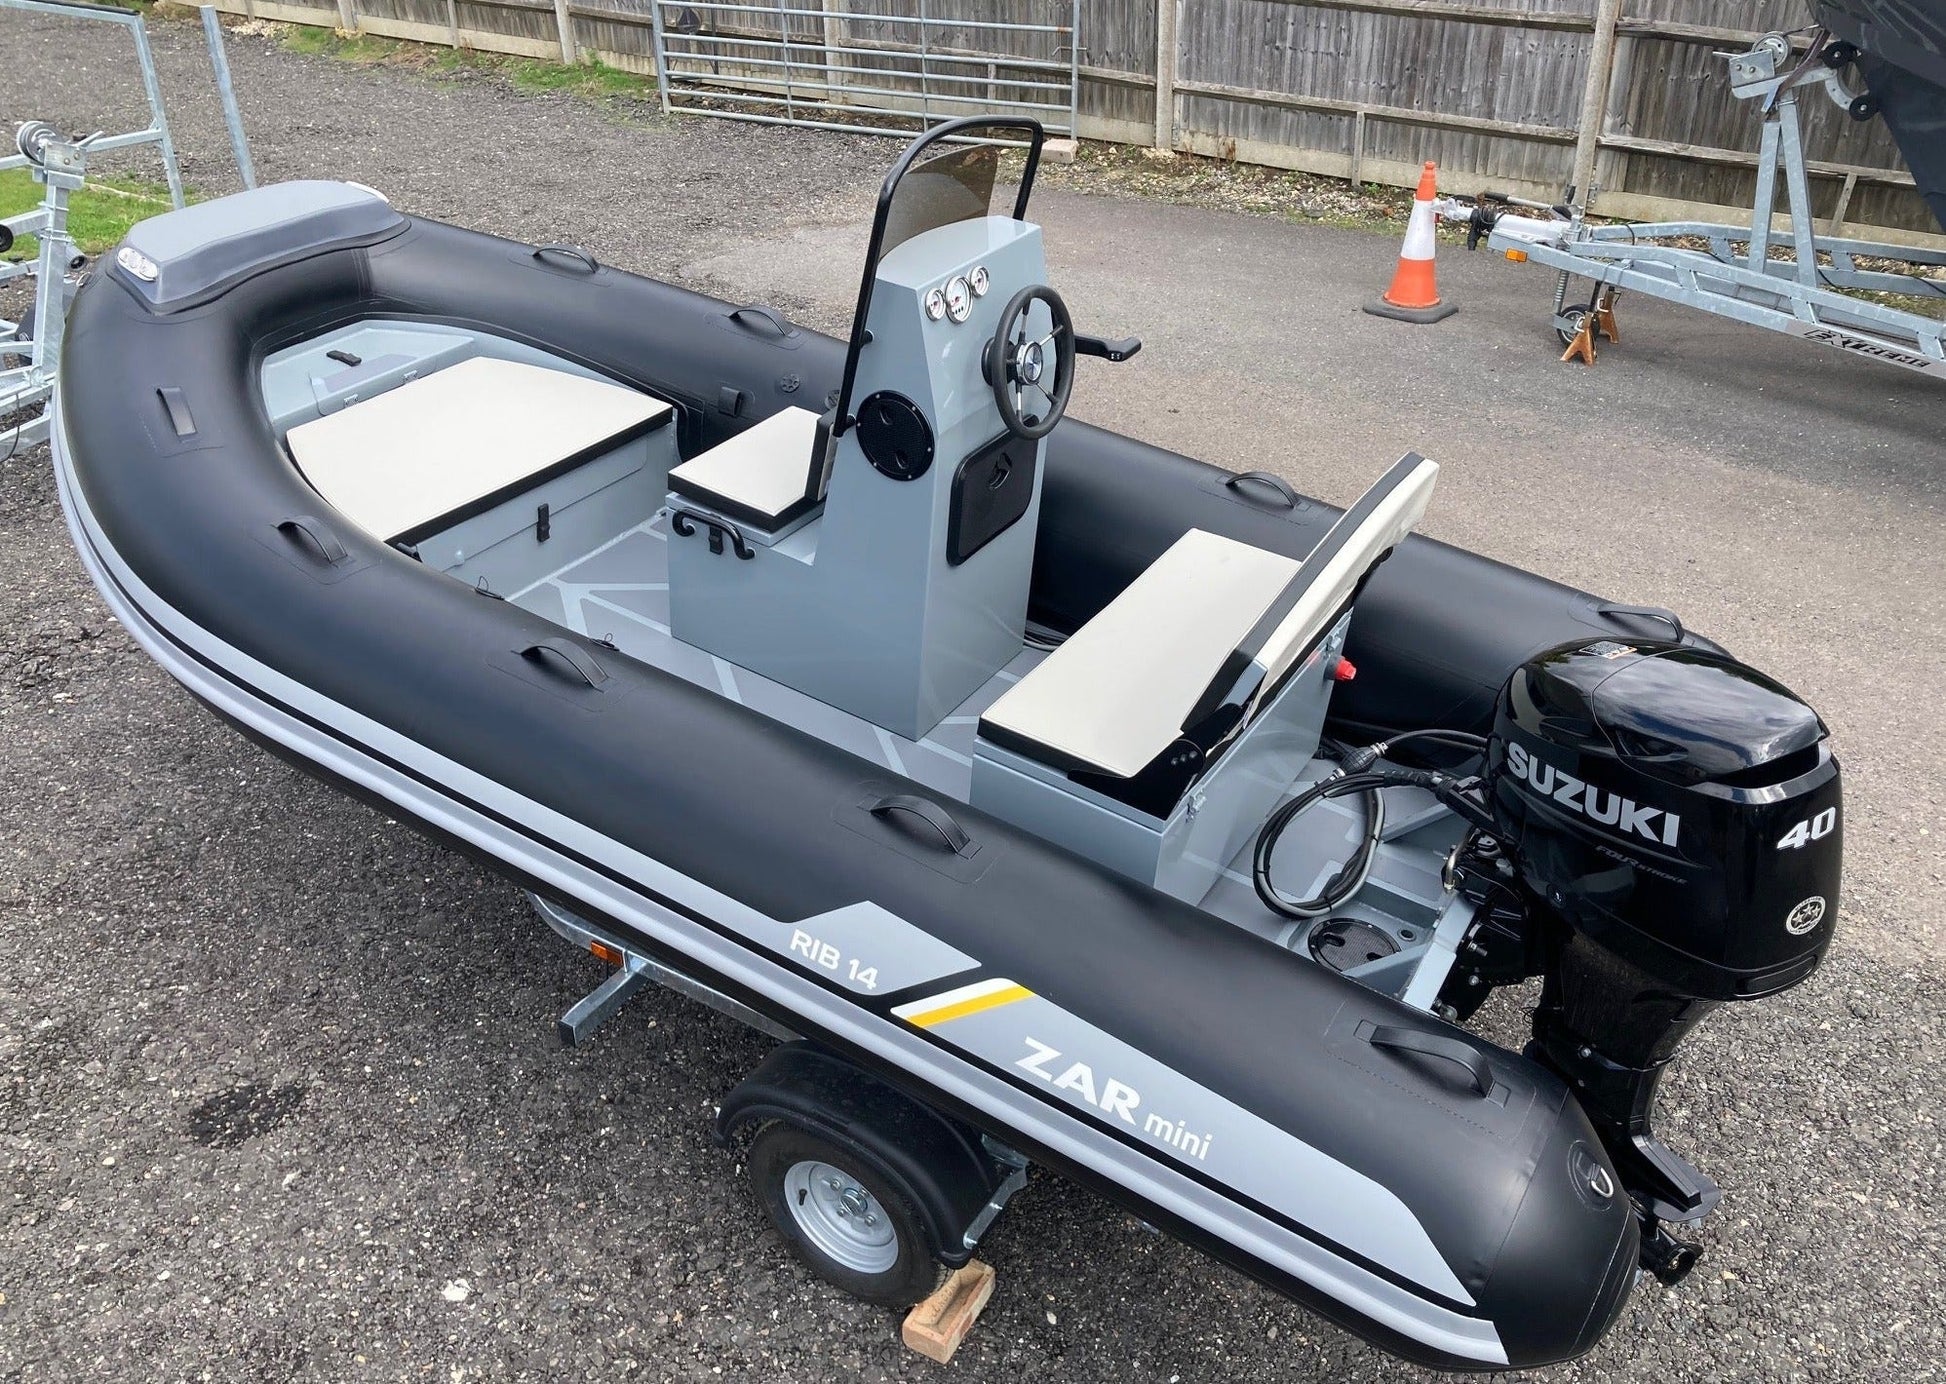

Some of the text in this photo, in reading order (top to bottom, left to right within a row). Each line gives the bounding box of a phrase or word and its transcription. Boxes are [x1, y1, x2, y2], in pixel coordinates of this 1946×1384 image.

[1507, 741, 1681, 849] SUZUKI
[1776, 806, 1837, 850] 40
[789, 928, 880, 991] RIB 14
[1014, 1036, 1214, 1162] ZAR mini
